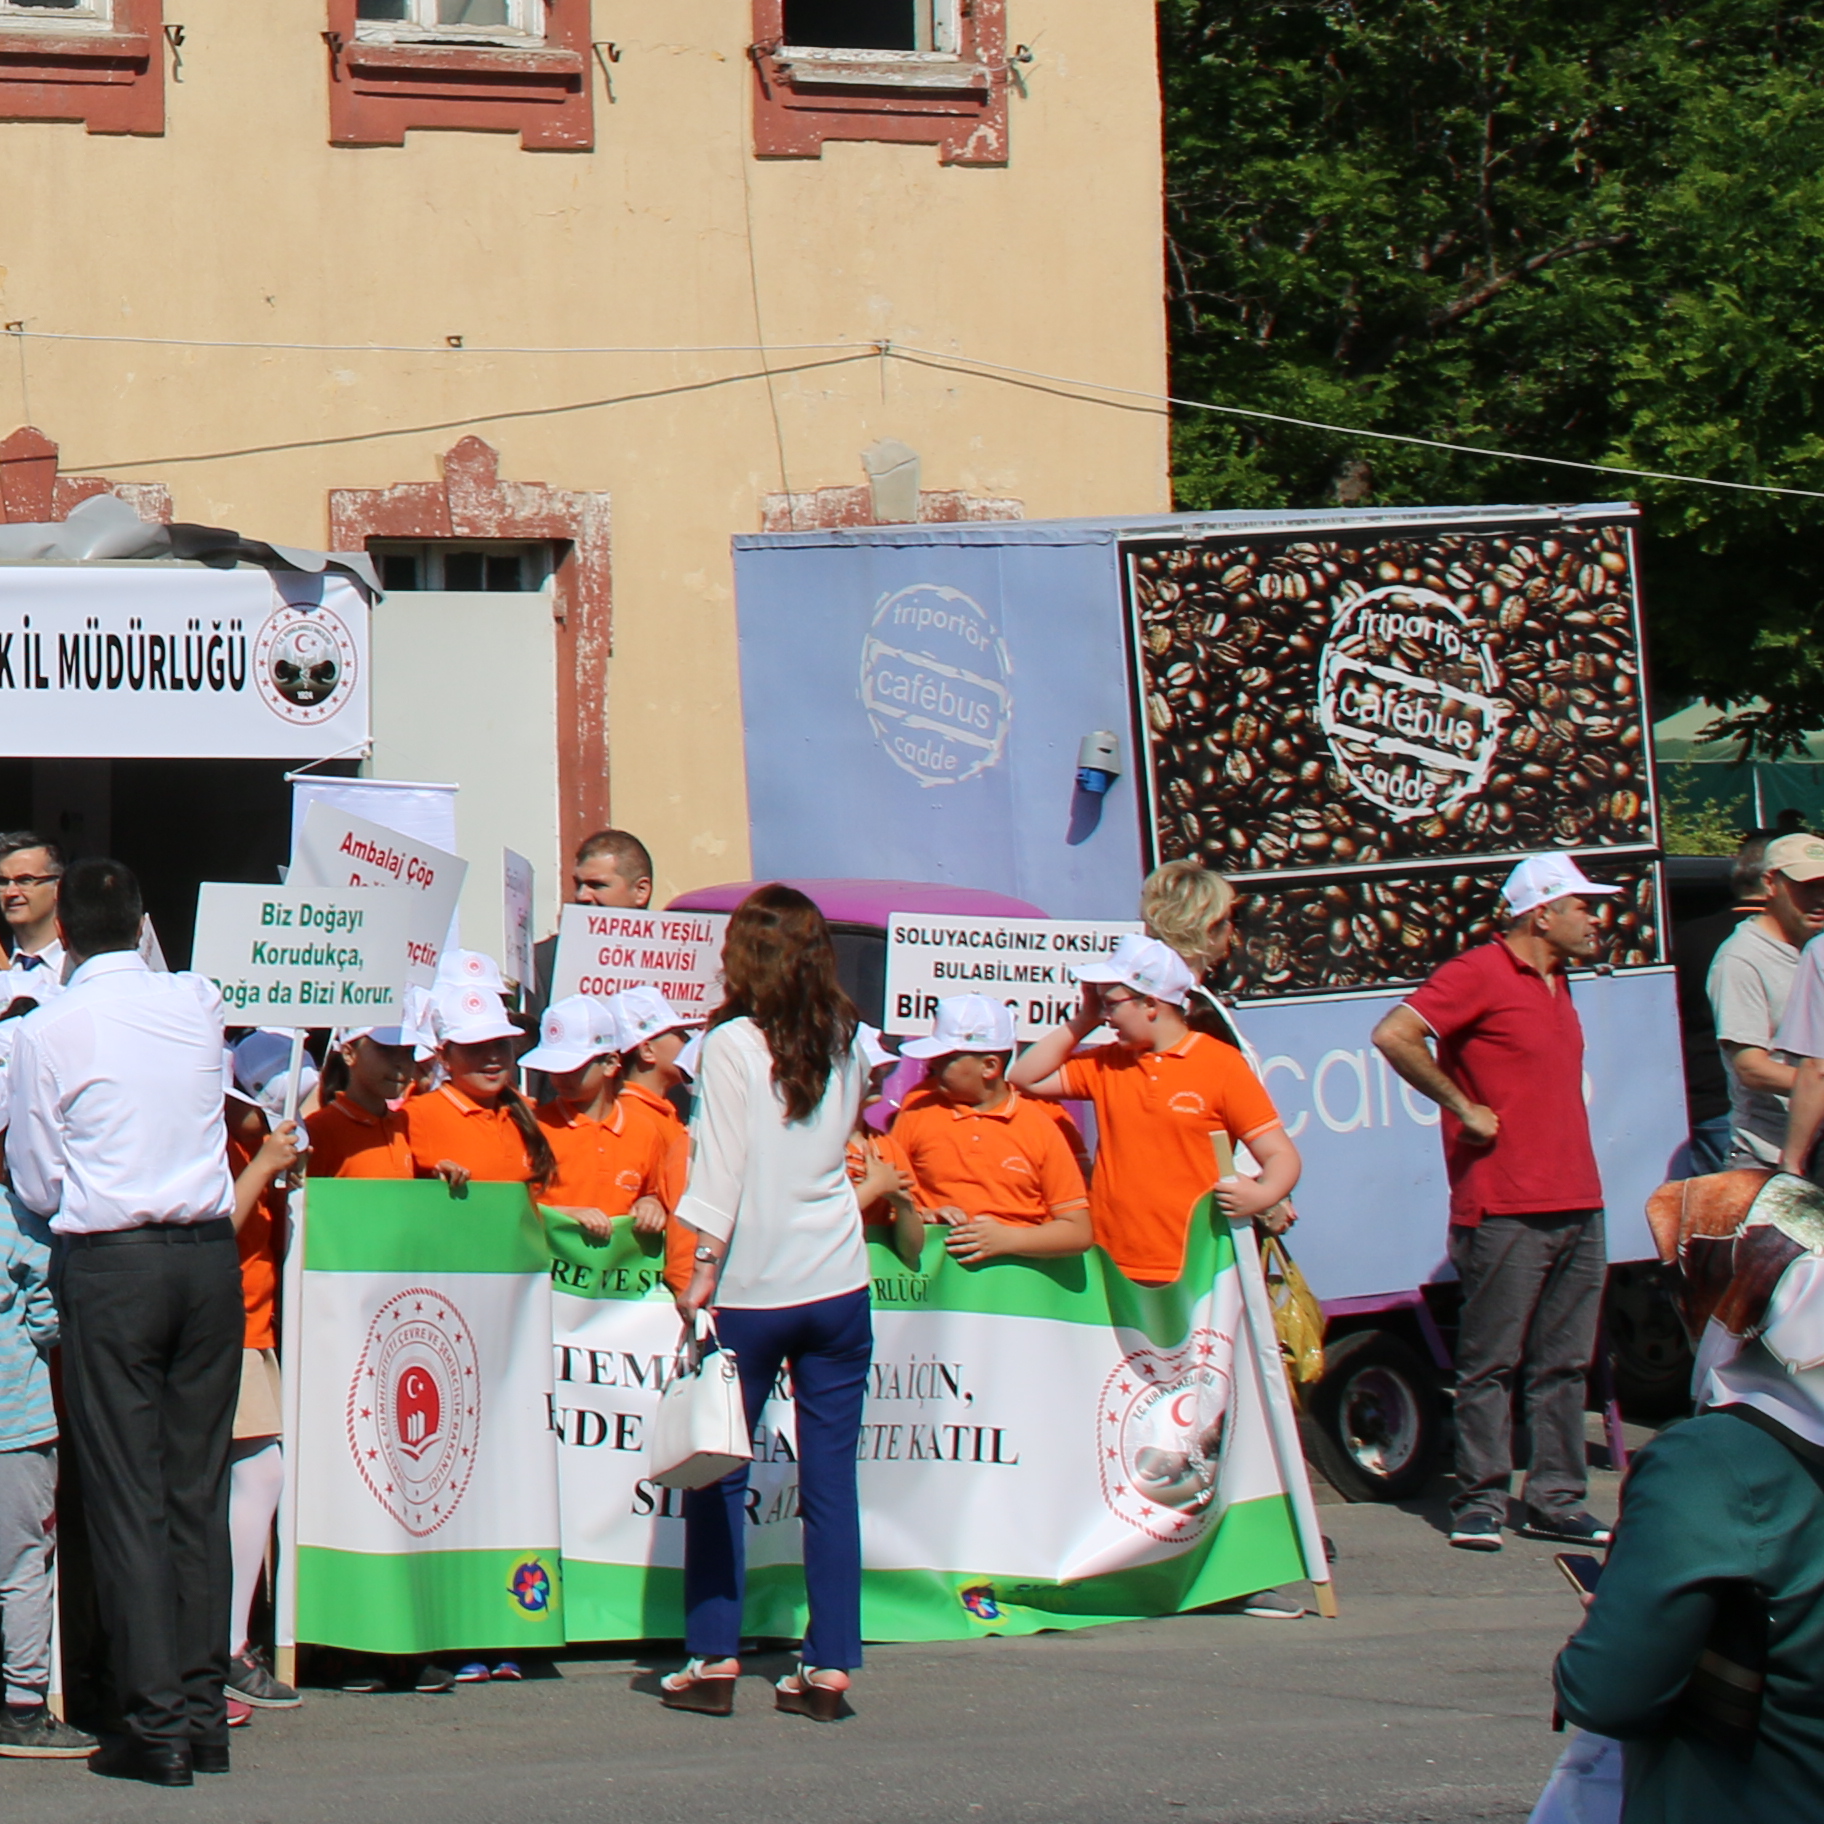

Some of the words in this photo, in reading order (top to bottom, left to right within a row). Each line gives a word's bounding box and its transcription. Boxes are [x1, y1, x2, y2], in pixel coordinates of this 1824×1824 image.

[893, 598, 990, 652] triportör
[1357, 602, 1478, 662] triportör
[22, 613, 50, 691] İL
[59, 616, 247, 692] MÜDÜRLÜĞÜ
[876, 670, 991, 729] cafébus
[1340, 686, 1473, 750] cafébus
[894, 736, 957, 770] cadde
[1361, 763, 1437, 801] cadde
[339, 831, 406, 880] Ambalaj
[406, 857, 434, 890] Çöp
[260, 903, 292, 927] Biz
[300, 902, 364, 934] Doğayı
[587, 916, 655, 938] YAPRAK
[661, 918, 714, 947] YEŞİLİ,
[252, 941, 364, 972] Korudukça,
[894, 927, 1046, 951] SOLUYACAĞINIZ
[1052, 931, 1123, 953] OKSİJE
[598, 943, 636, 968] GÖK
[640, 946, 696, 972] MAVİSİ
[933, 960, 1055, 984] BULABİLMEK
[268, 981, 292, 1005] da
[299, 980, 335, 1005] Bizi
[341, 981, 393, 1005] Korur.
[896, 988, 940, 1019] BİR
[398, 1327, 427, 1345] ÇEVRE
[428, 1330, 440, 1346] VE
[906, 1353, 974, 1409] İÇİN,
[907, 1424, 1022, 1466] KATIL
